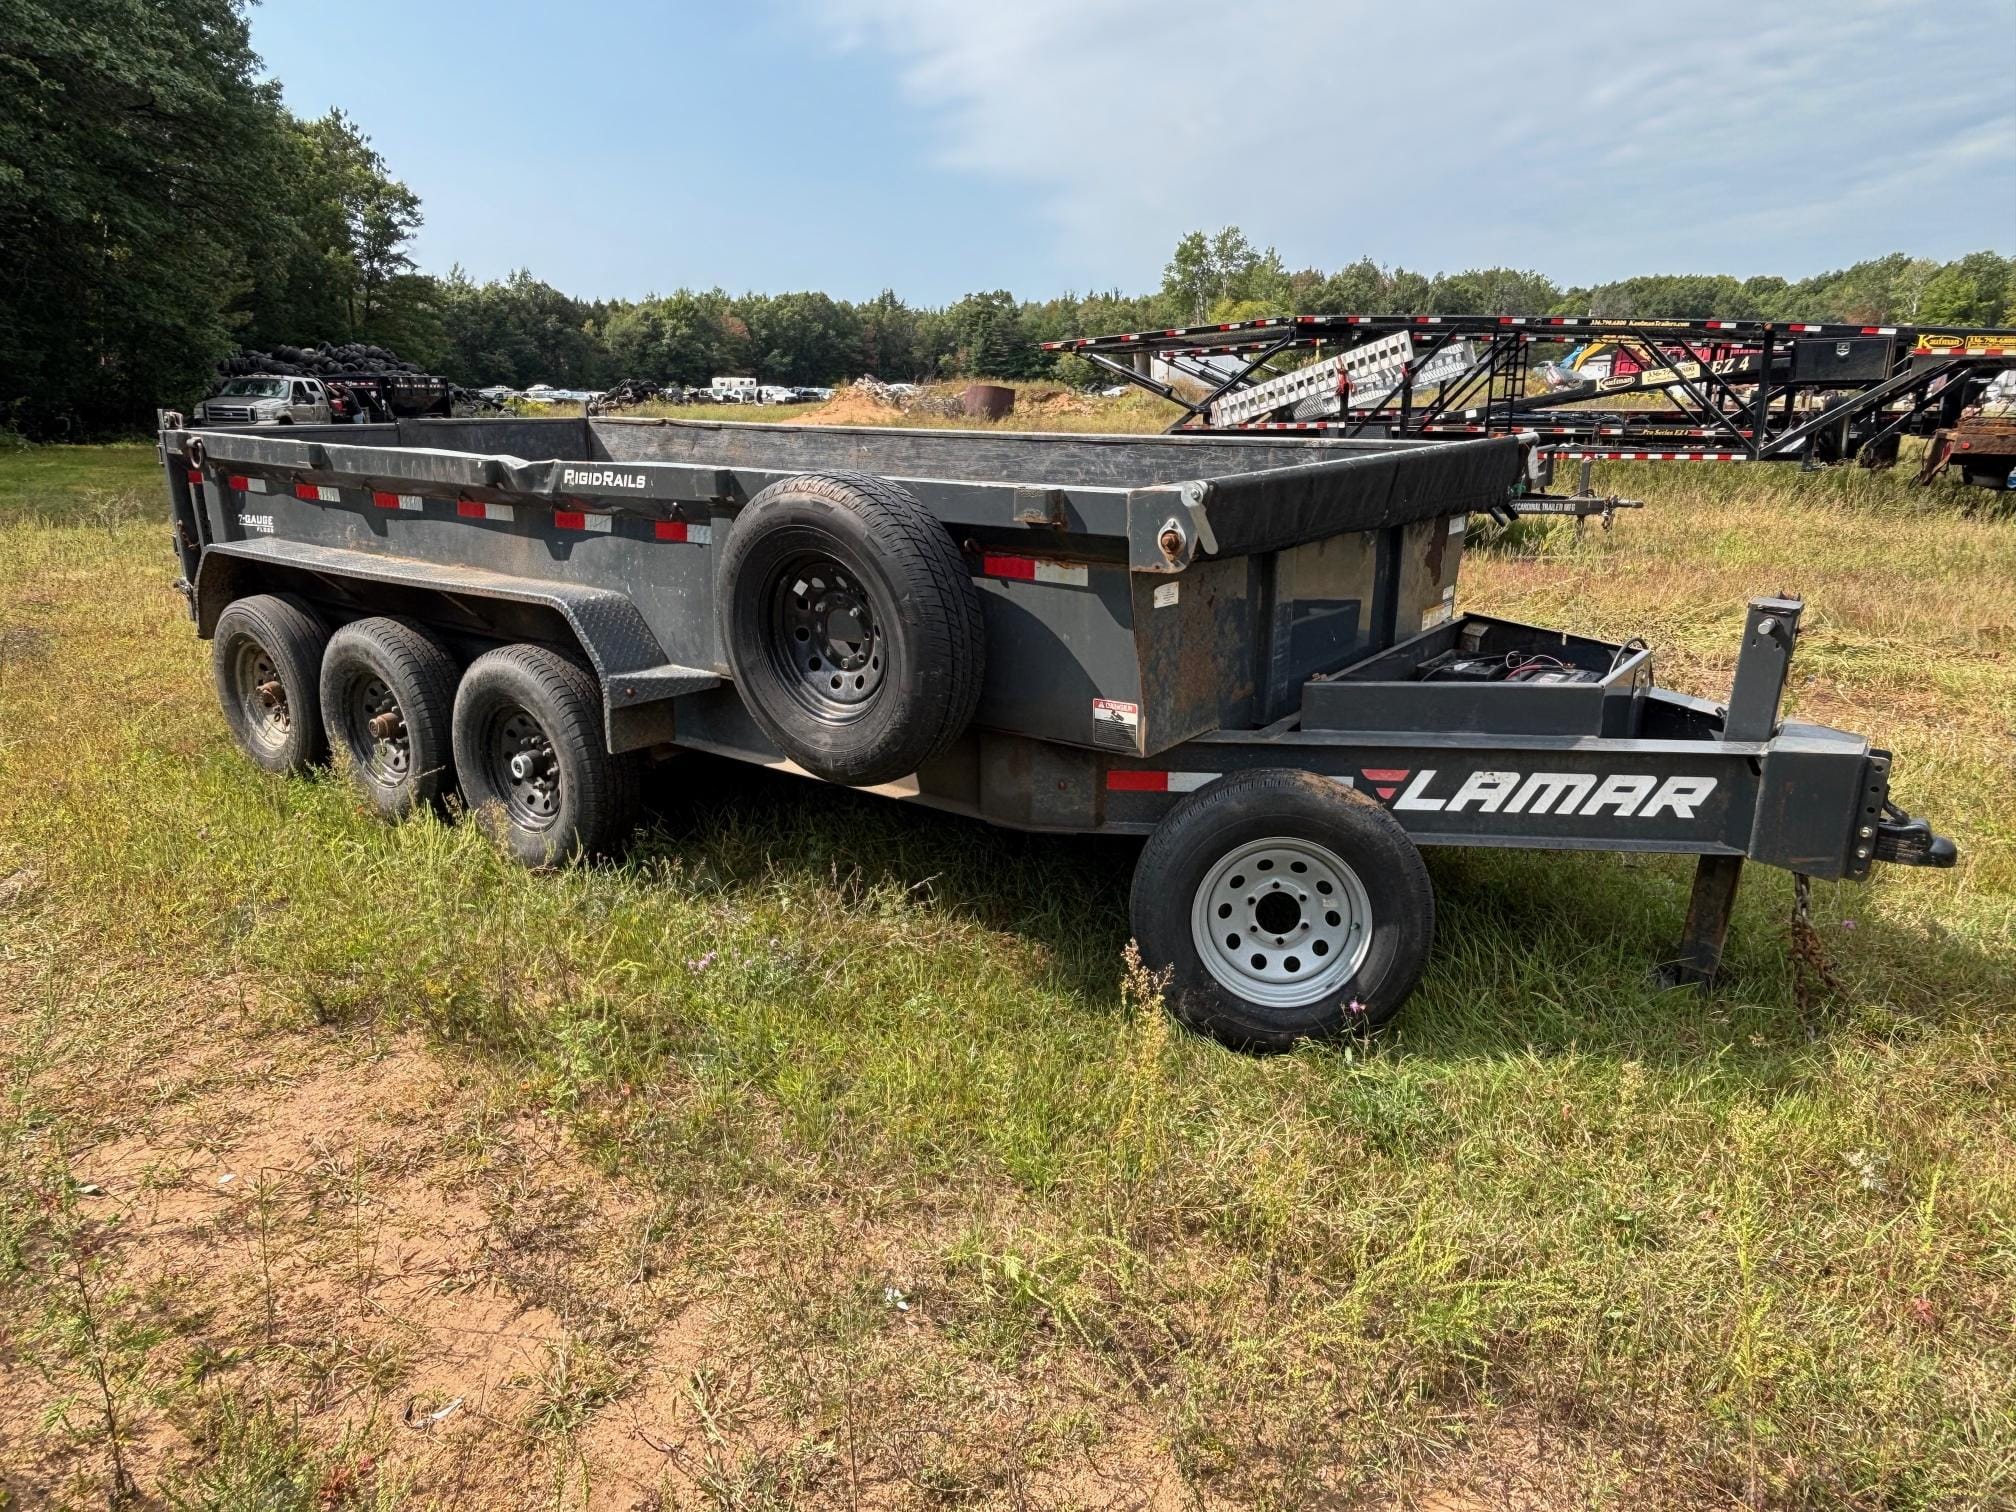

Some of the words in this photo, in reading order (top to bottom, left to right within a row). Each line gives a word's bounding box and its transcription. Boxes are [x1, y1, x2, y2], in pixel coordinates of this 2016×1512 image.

[1918, 335, 1962, 349] Kaufman
[1711, 358, 1736, 375] EZ
[1738, 356, 1750, 370] 4
[1393, 770, 1718, 818] LAMAR
